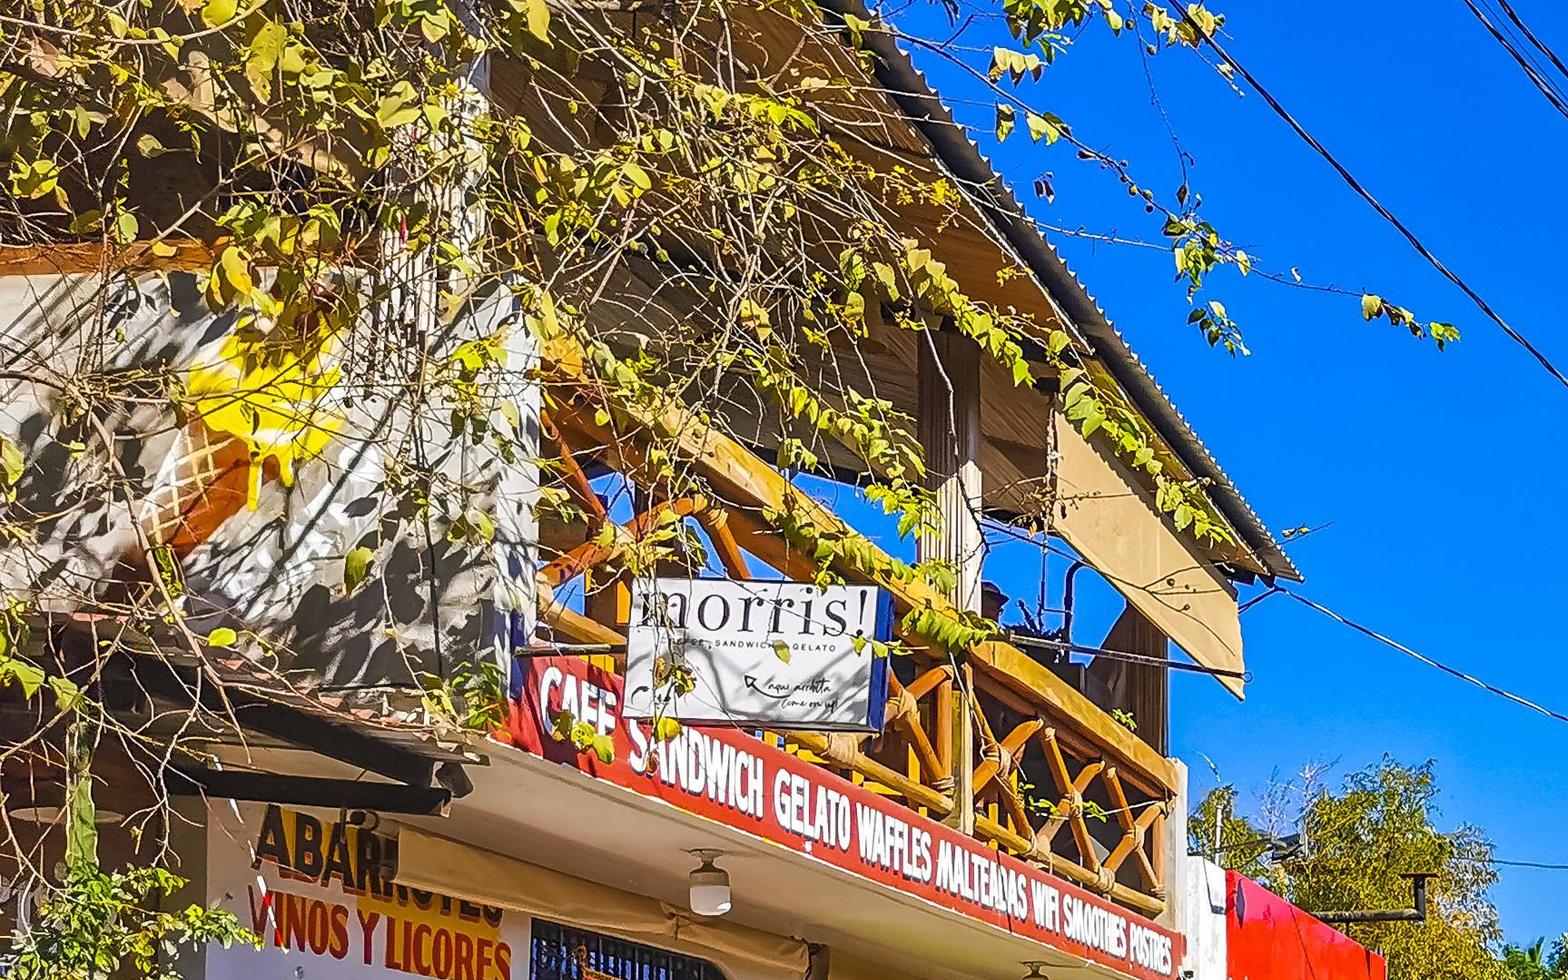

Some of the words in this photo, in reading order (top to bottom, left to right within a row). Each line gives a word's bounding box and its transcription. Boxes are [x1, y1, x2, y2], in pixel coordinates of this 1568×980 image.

[636, 588, 868, 636] morris!
[793, 643, 836, 652] GELATO
[628, 718, 765, 820] SANDWICH
[773, 768, 850, 851] GELATO
[856, 802, 932, 884] WAFFLES
[936, 839, 1028, 923] MALTEADAS
[1031, 878, 1060, 934] WIFI
[1129, 921, 1173, 976] POSTRES
[248, 884, 350, 960] VINOS
[357, 908, 381, 965] Y
